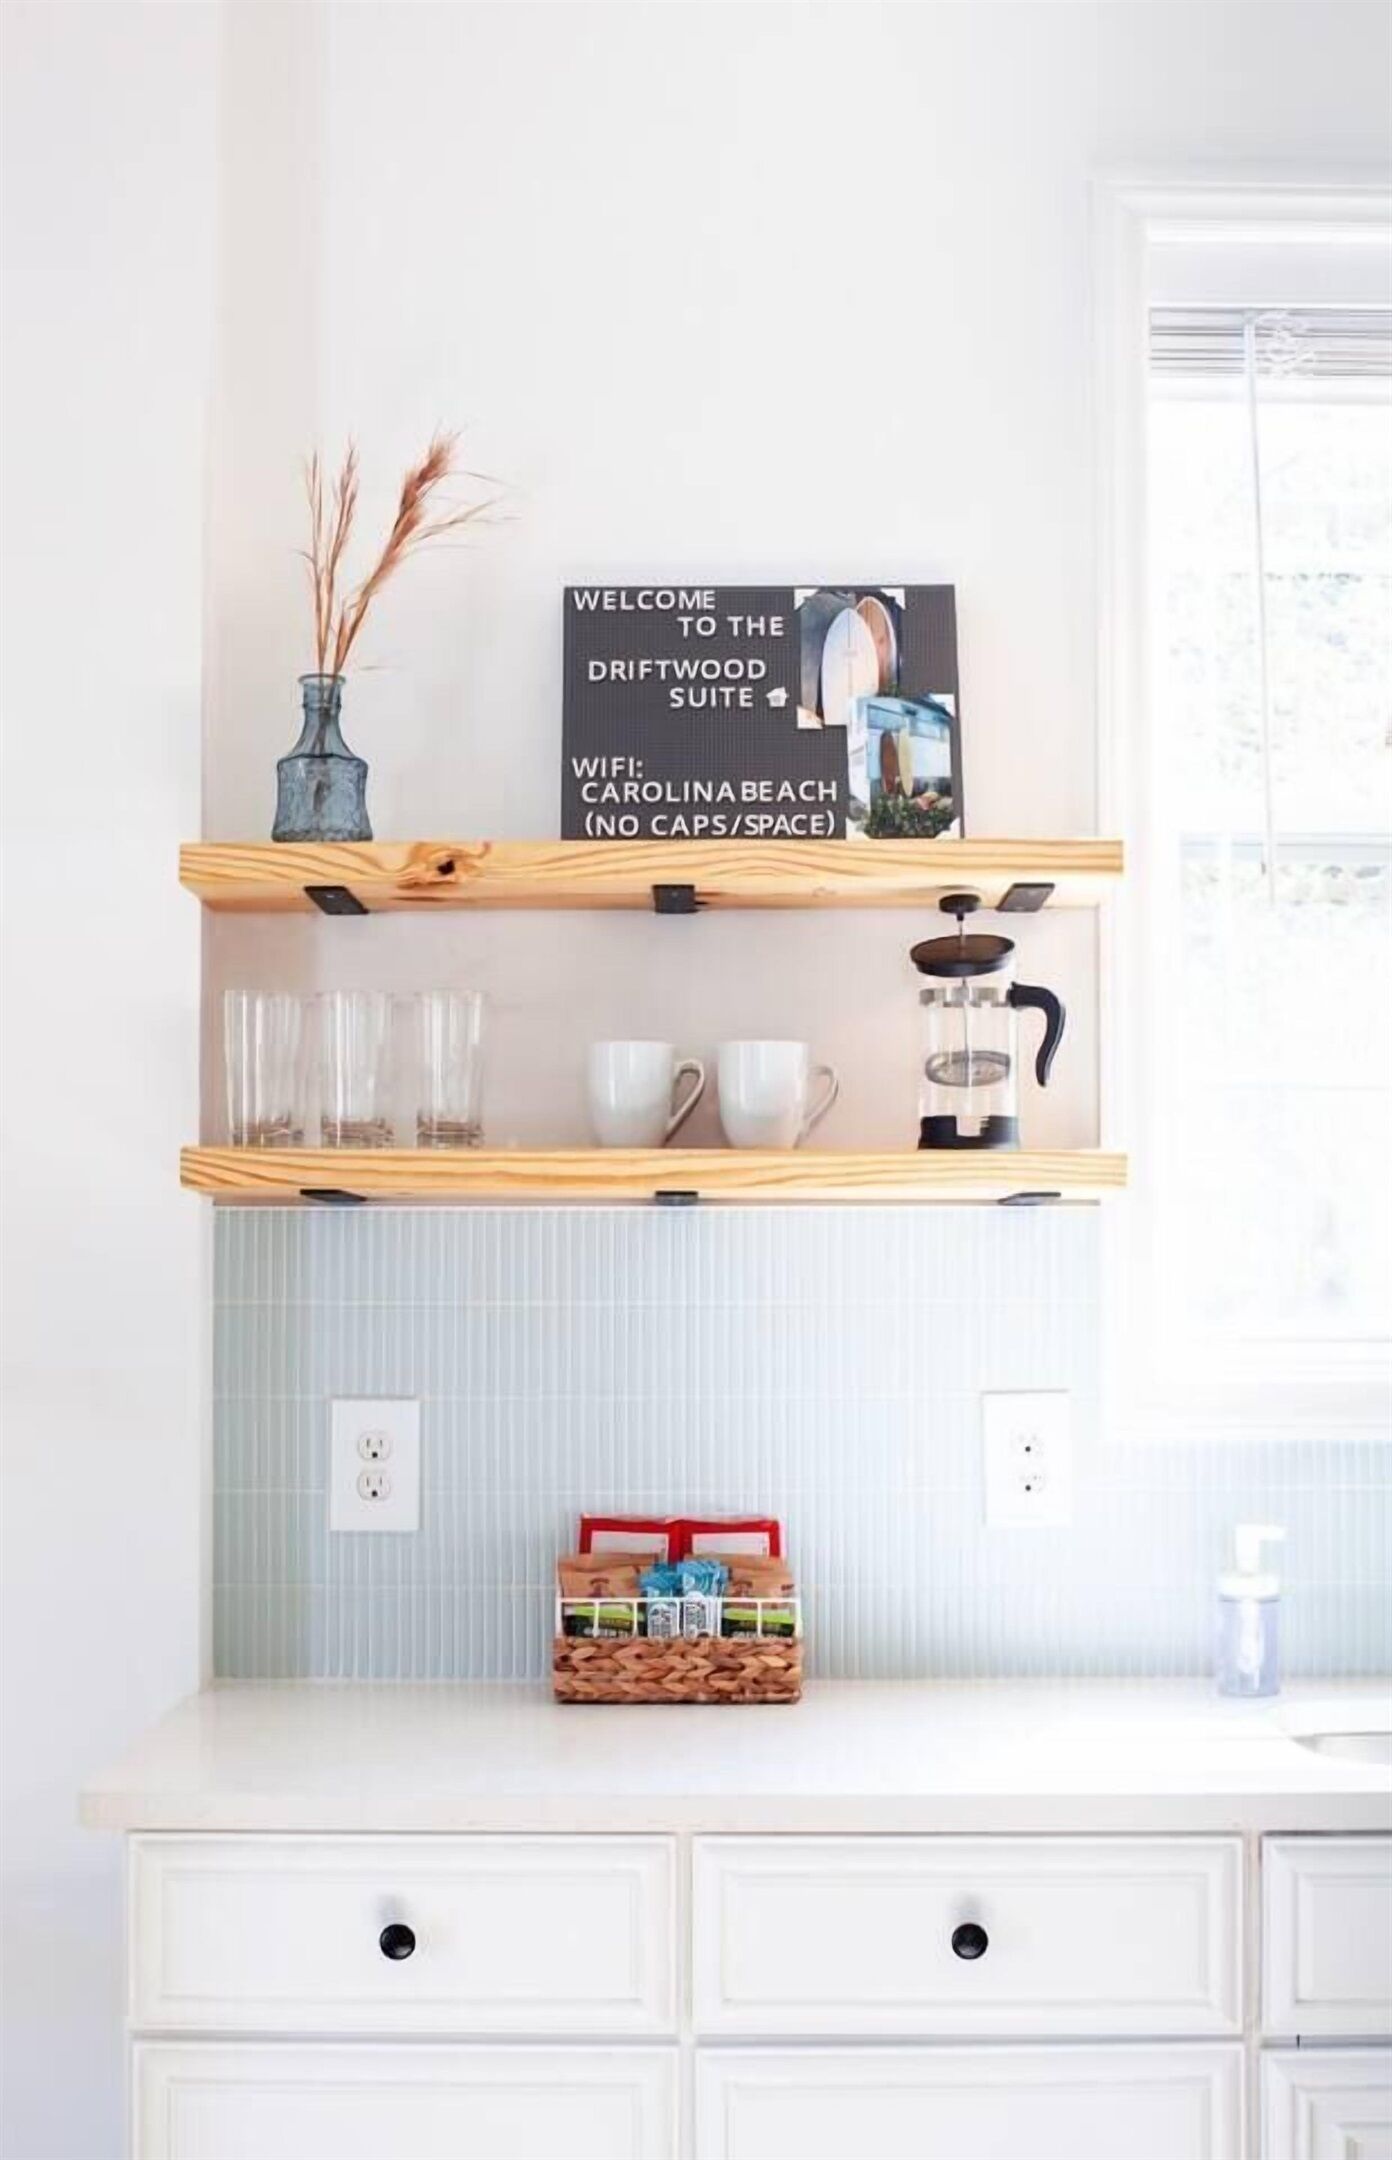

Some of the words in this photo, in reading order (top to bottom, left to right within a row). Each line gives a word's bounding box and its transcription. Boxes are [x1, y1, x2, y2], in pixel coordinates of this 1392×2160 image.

[573, 589, 716, 611] WELCOME
[677, 616, 717, 637] TO
[726, 615, 784, 637] THE
[588, 659, 766, 681] DRIFTWOOD
[669, 687, 753, 708] SUITE
[572, 757, 643, 779] WIFI:
[585, 811, 639, 837] (NO
[651, 810, 835, 837] CAPS/SPACE)
